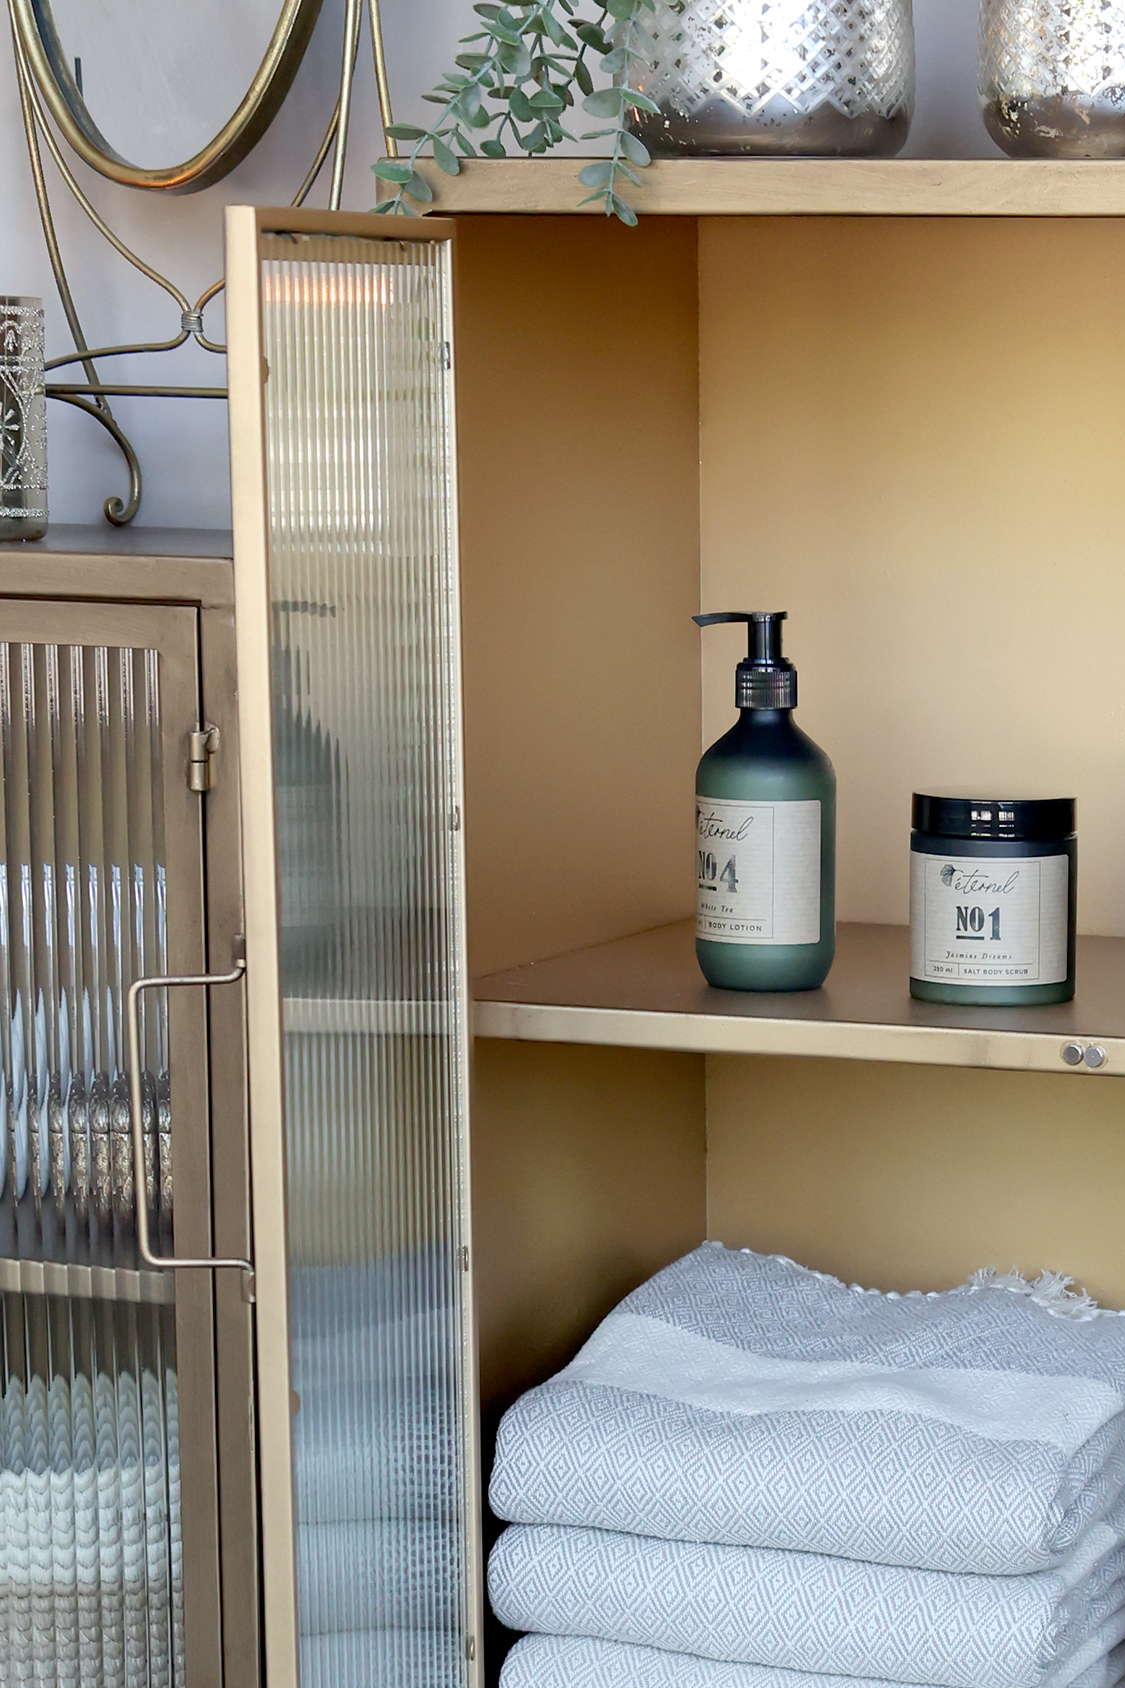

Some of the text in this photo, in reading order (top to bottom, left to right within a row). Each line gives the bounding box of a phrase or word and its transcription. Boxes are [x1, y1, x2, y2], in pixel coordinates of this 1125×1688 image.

[954, 869, 1020, 895] éternel
[708, 921, 727, 929] BODY
[730, 924, 763, 932] LOTION
[945, 951, 1013, 960] Jasmine Dreams
